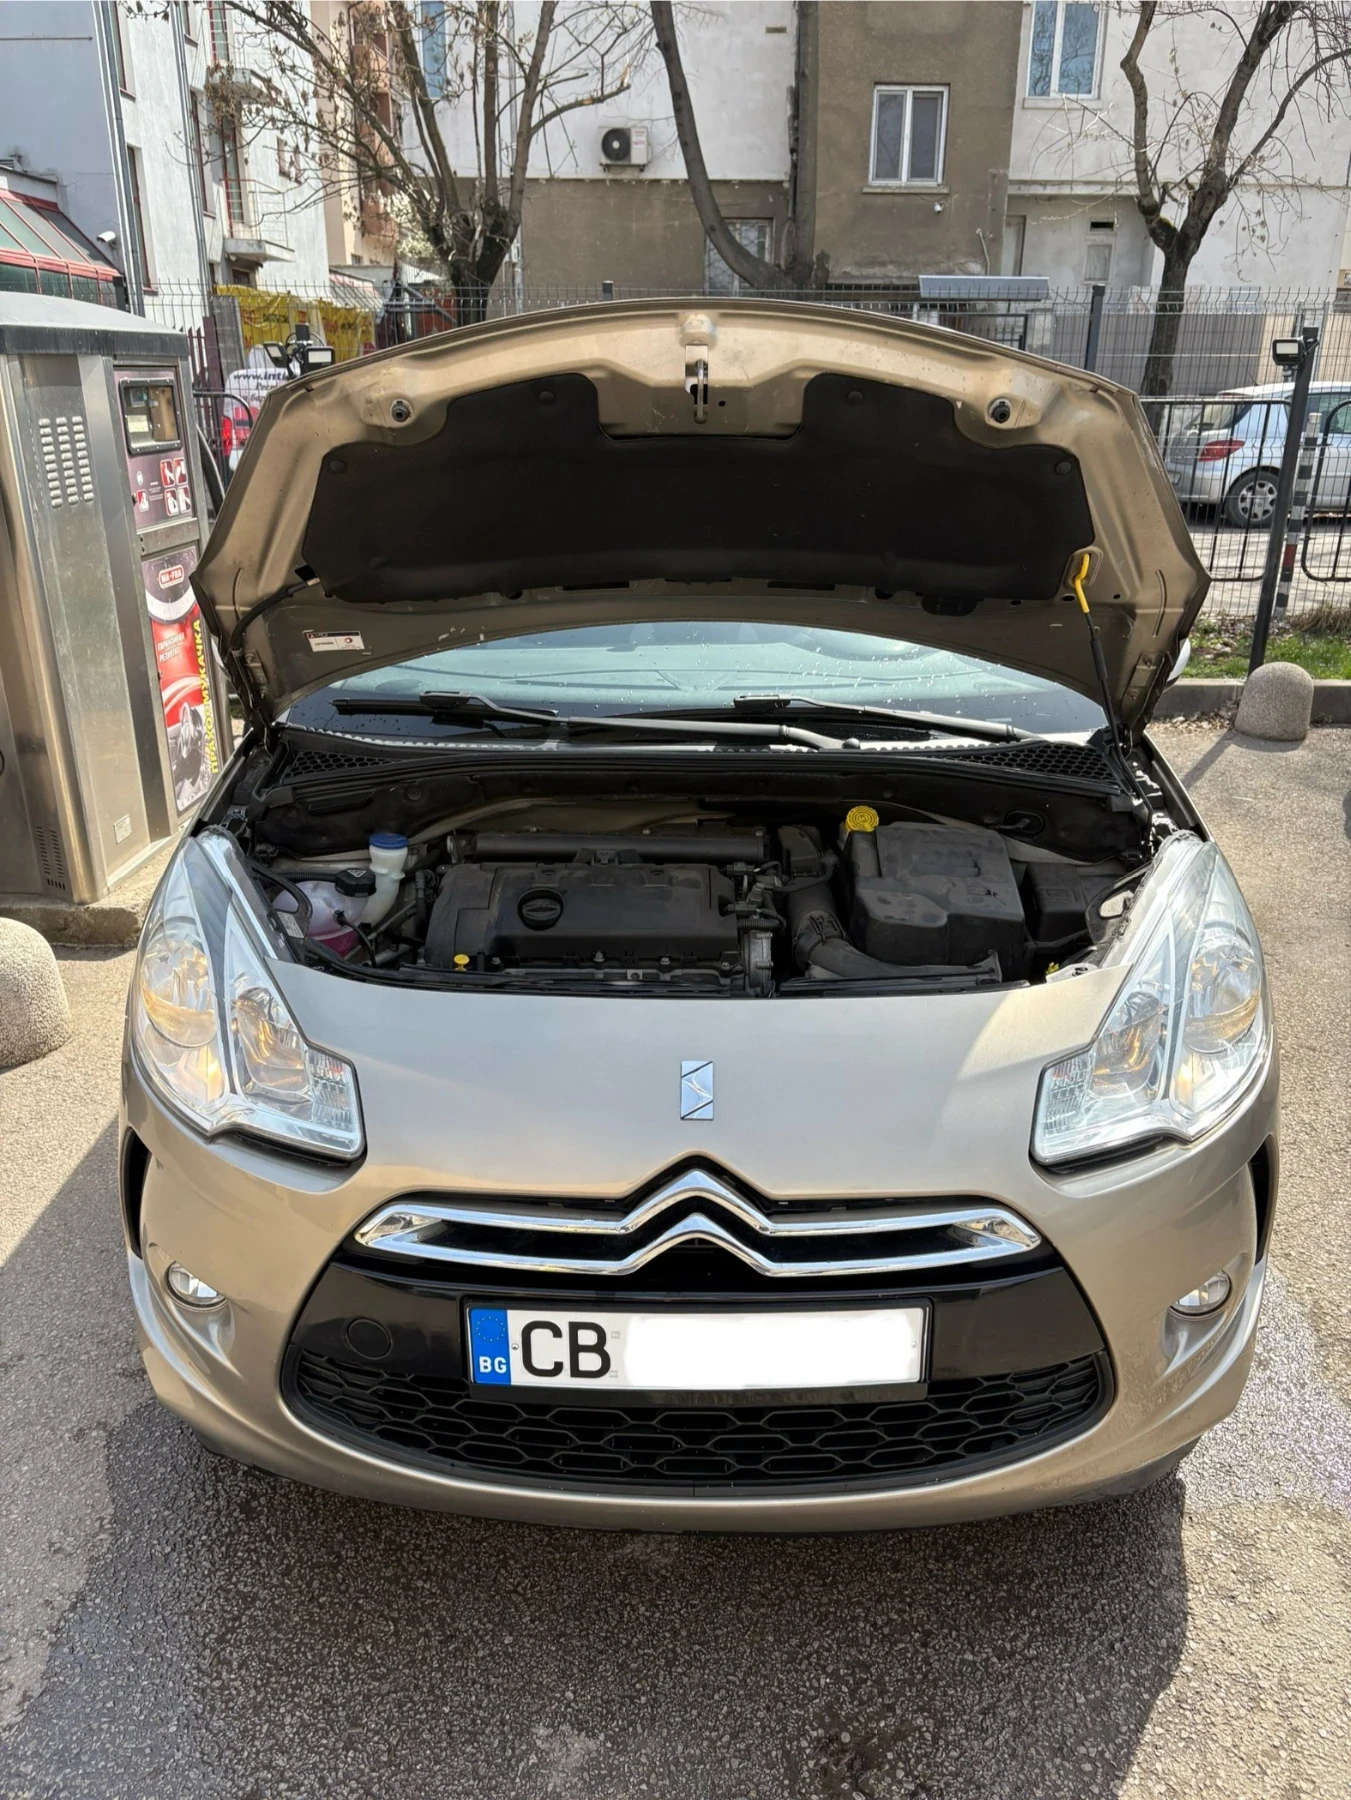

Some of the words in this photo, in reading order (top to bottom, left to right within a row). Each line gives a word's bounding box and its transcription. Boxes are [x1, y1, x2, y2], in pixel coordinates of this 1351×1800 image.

[193, 619, 219, 774] ПРАХОСМУКАЧКА
[479, 1356, 507, 1373] BG
[521, 1320, 611, 1378] CB
